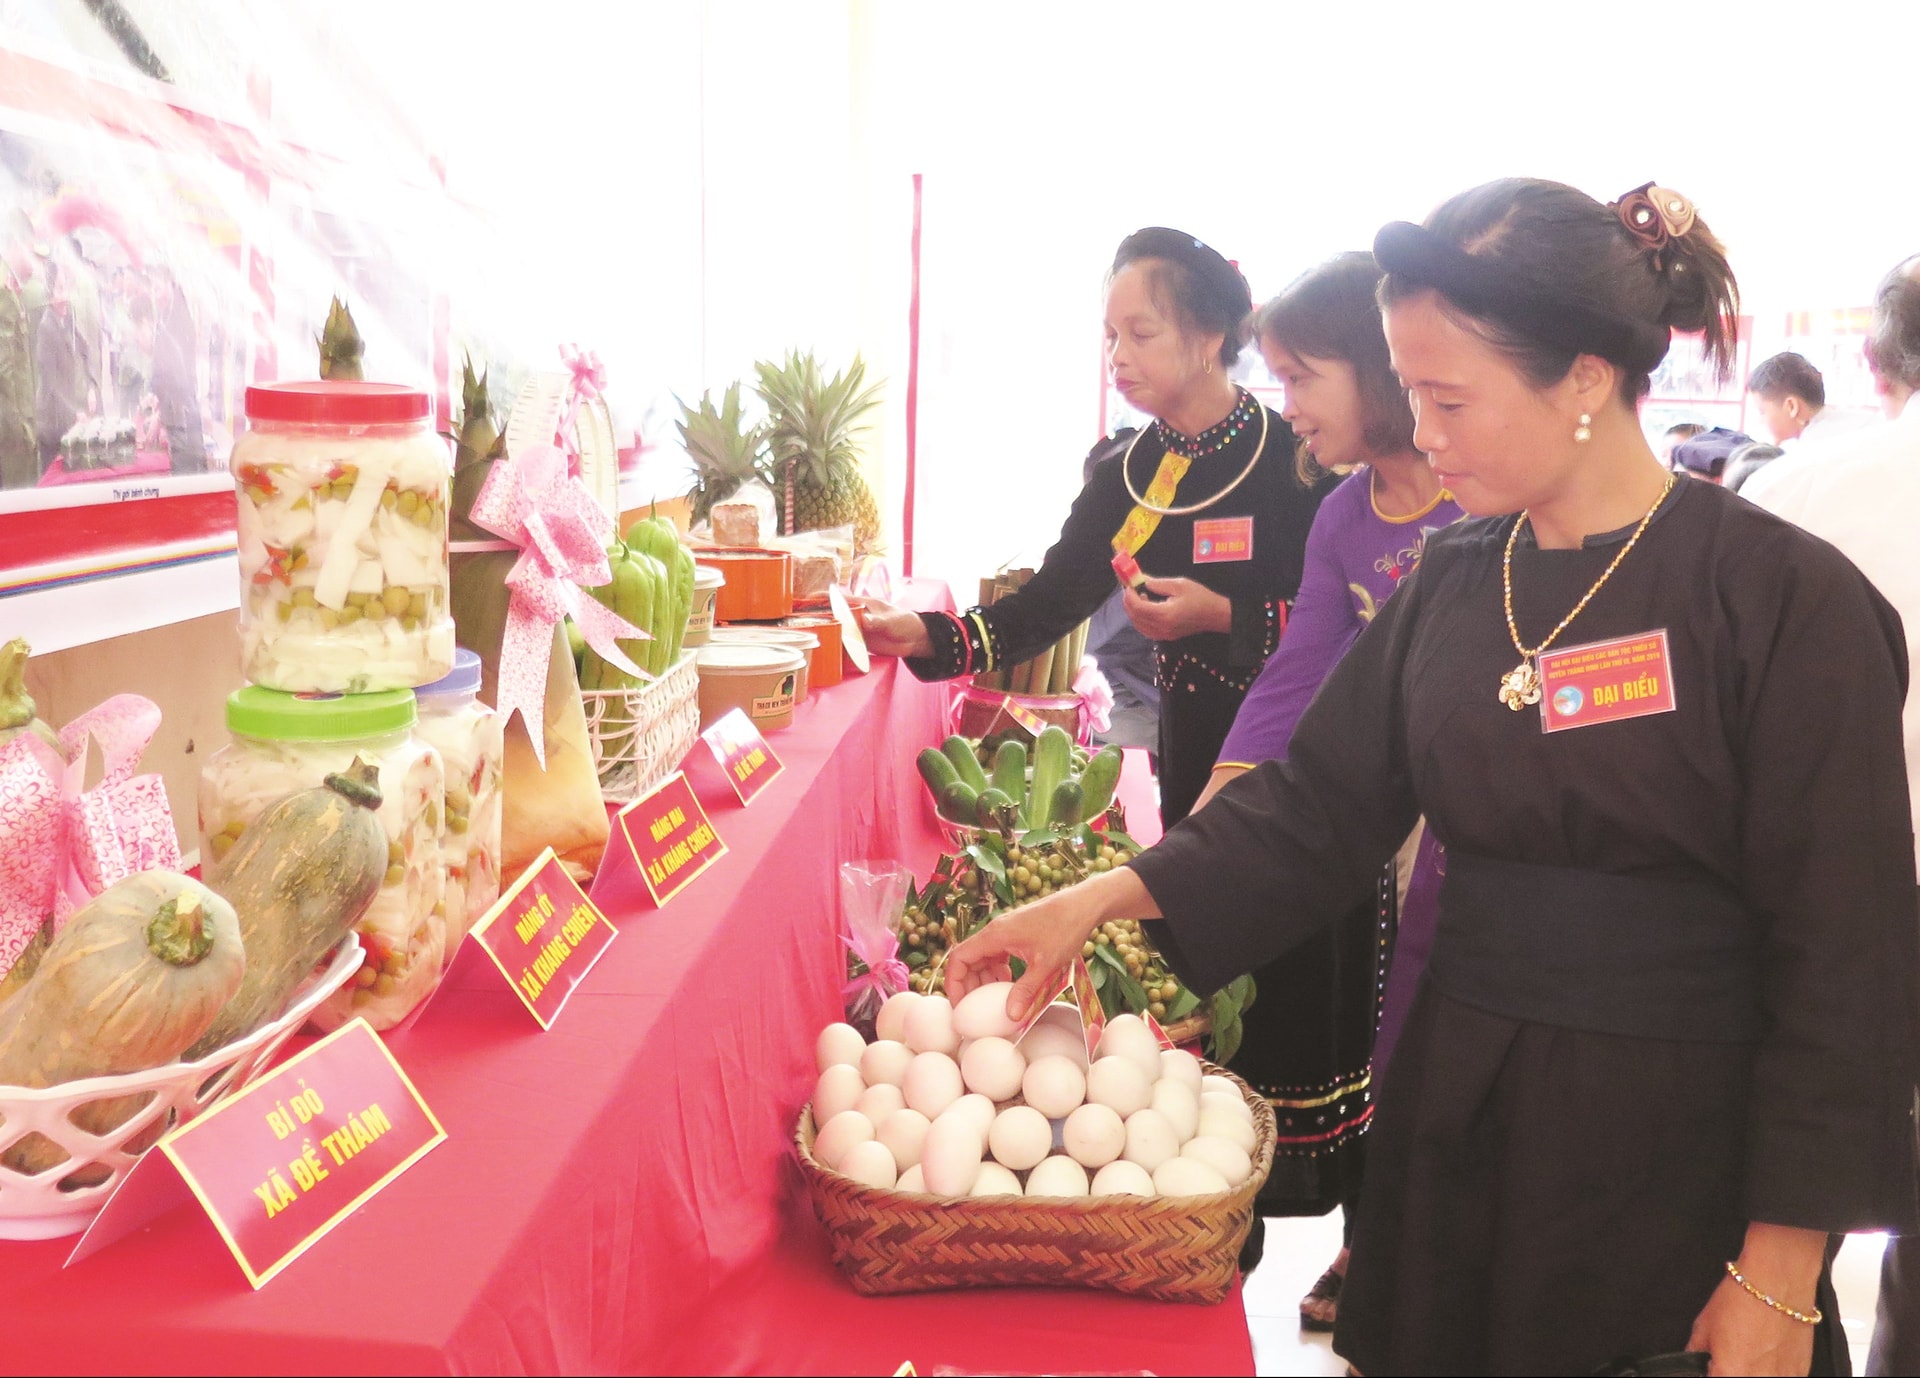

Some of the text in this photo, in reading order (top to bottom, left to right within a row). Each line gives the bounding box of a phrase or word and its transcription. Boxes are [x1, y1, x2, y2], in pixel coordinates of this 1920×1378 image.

[1592, 671, 1659, 708] ĐẠI BIỂU
[647, 820, 715, 887] XÃ KHÁNG CHIẾN
[649, 806, 687, 843] MĂNG MAI
[514, 893, 556, 945] MĂNG ỚT
[519, 902, 598, 1002] XÃ KHÁNG CHIẾN
[265, 1078, 325, 1141] BÍ ĐỎ
[253, 1103, 392, 1219] XÃ ĐỀ THÁM
